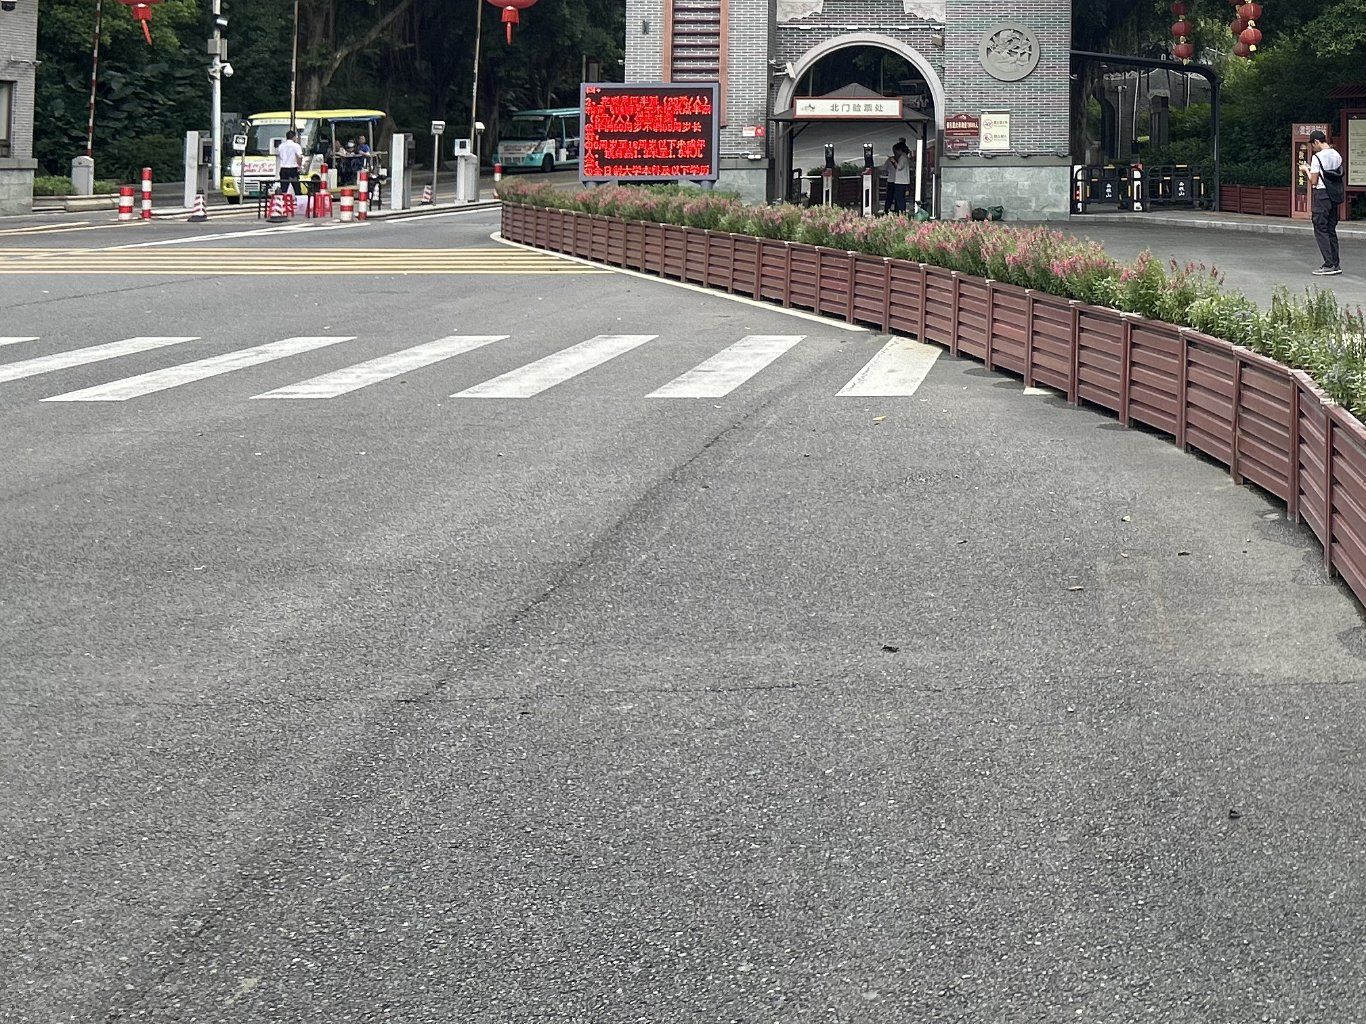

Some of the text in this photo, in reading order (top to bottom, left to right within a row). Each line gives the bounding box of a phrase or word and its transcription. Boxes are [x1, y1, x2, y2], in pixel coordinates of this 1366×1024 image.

[830, 103, 884, 112] 北门验票处
